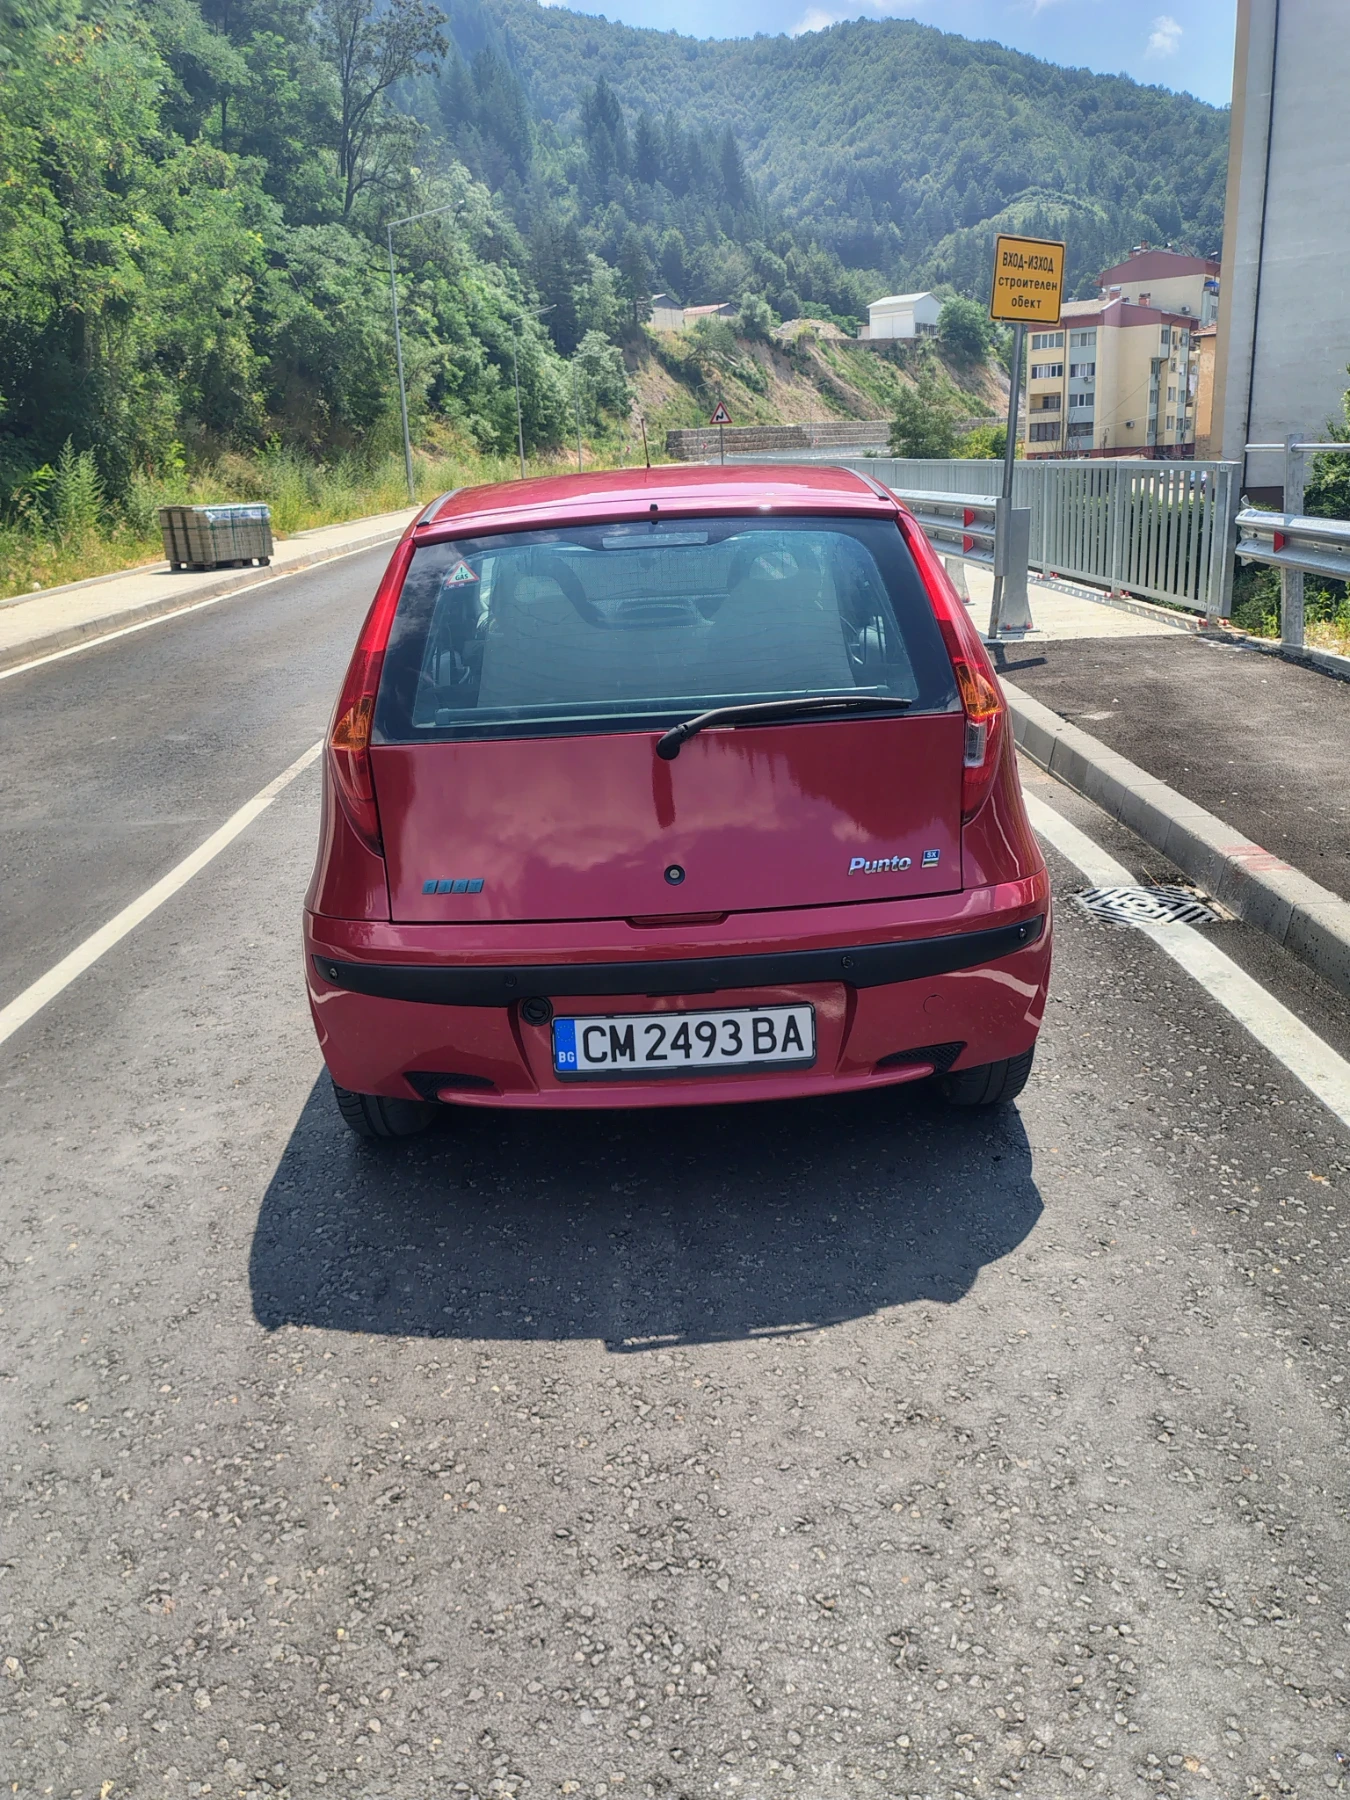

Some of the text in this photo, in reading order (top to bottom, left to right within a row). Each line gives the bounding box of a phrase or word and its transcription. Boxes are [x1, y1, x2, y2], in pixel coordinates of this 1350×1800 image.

[1002, 252, 1054, 274] ВХОД-ИЗХОД
[998, 276, 1058, 291] строителен
[1011, 295, 1042, 309] обект
[848, 855, 912, 876] Punto
[422, 879, 484, 893] FIAT
[558, 1051, 575, 1063] BG
